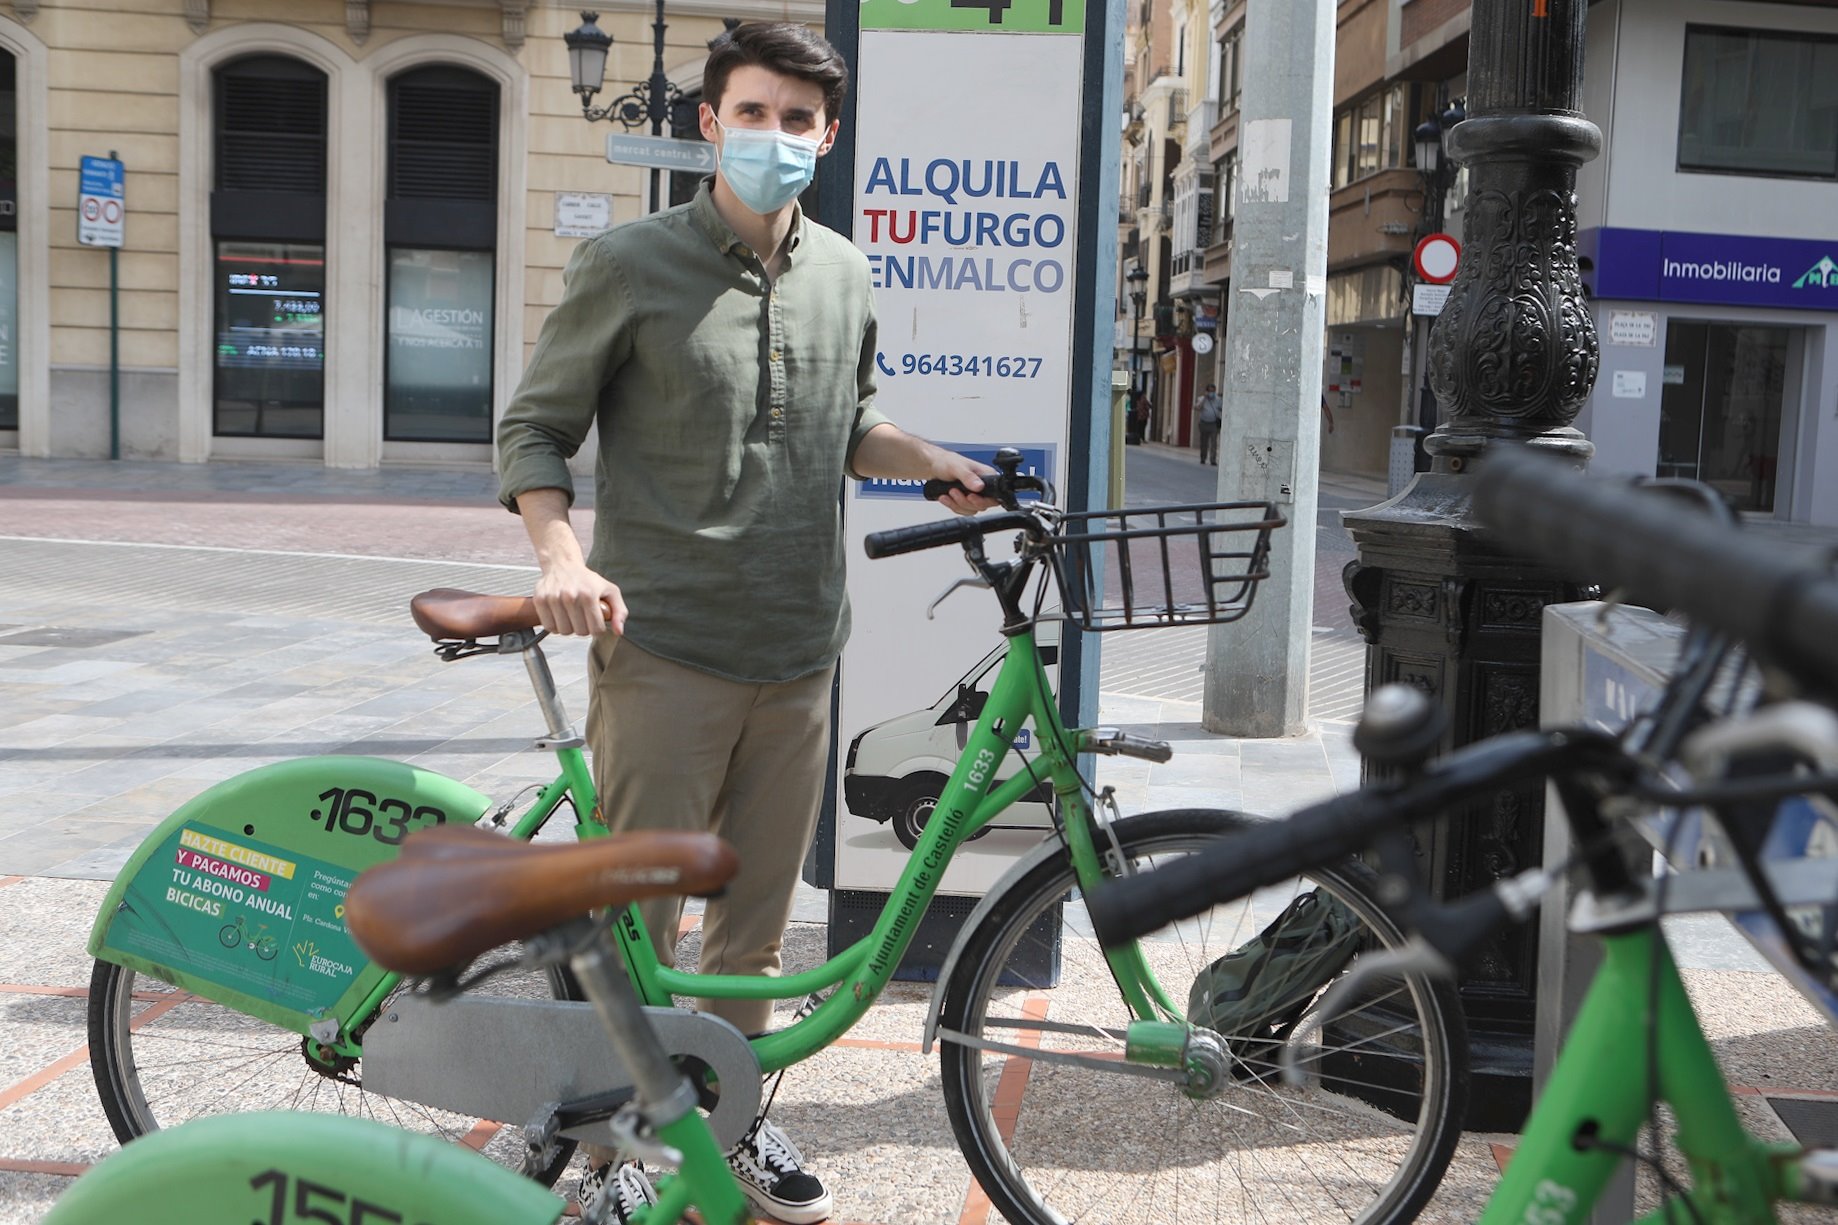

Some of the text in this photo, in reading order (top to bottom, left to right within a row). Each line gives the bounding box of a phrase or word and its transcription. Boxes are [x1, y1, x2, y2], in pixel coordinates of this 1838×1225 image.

[613, 144, 692, 160] mercat central
[864, 157, 1067, 205] ALQUILA
[1663, 258, 1781, 283] Inmobiliaria
[902, 353, 1043, 379] 964341627
[963, 748, 995, 793] 1633
[181, 830, 288, 876] HAZTE CLIENTE
[177, 849, 262, 889] Y PAGAMOS
[166, 887, 221, 917] BICICAS
[172, 868, 292, 920] TU ABONO ANUAL
[868, 807, 964, 976] Ajuntament de Castelló
[314, 917, 342, 932] Cardona
[308, 962, 337, 978] RURAL
[311, 955, 353, 975] EUROCAJA
